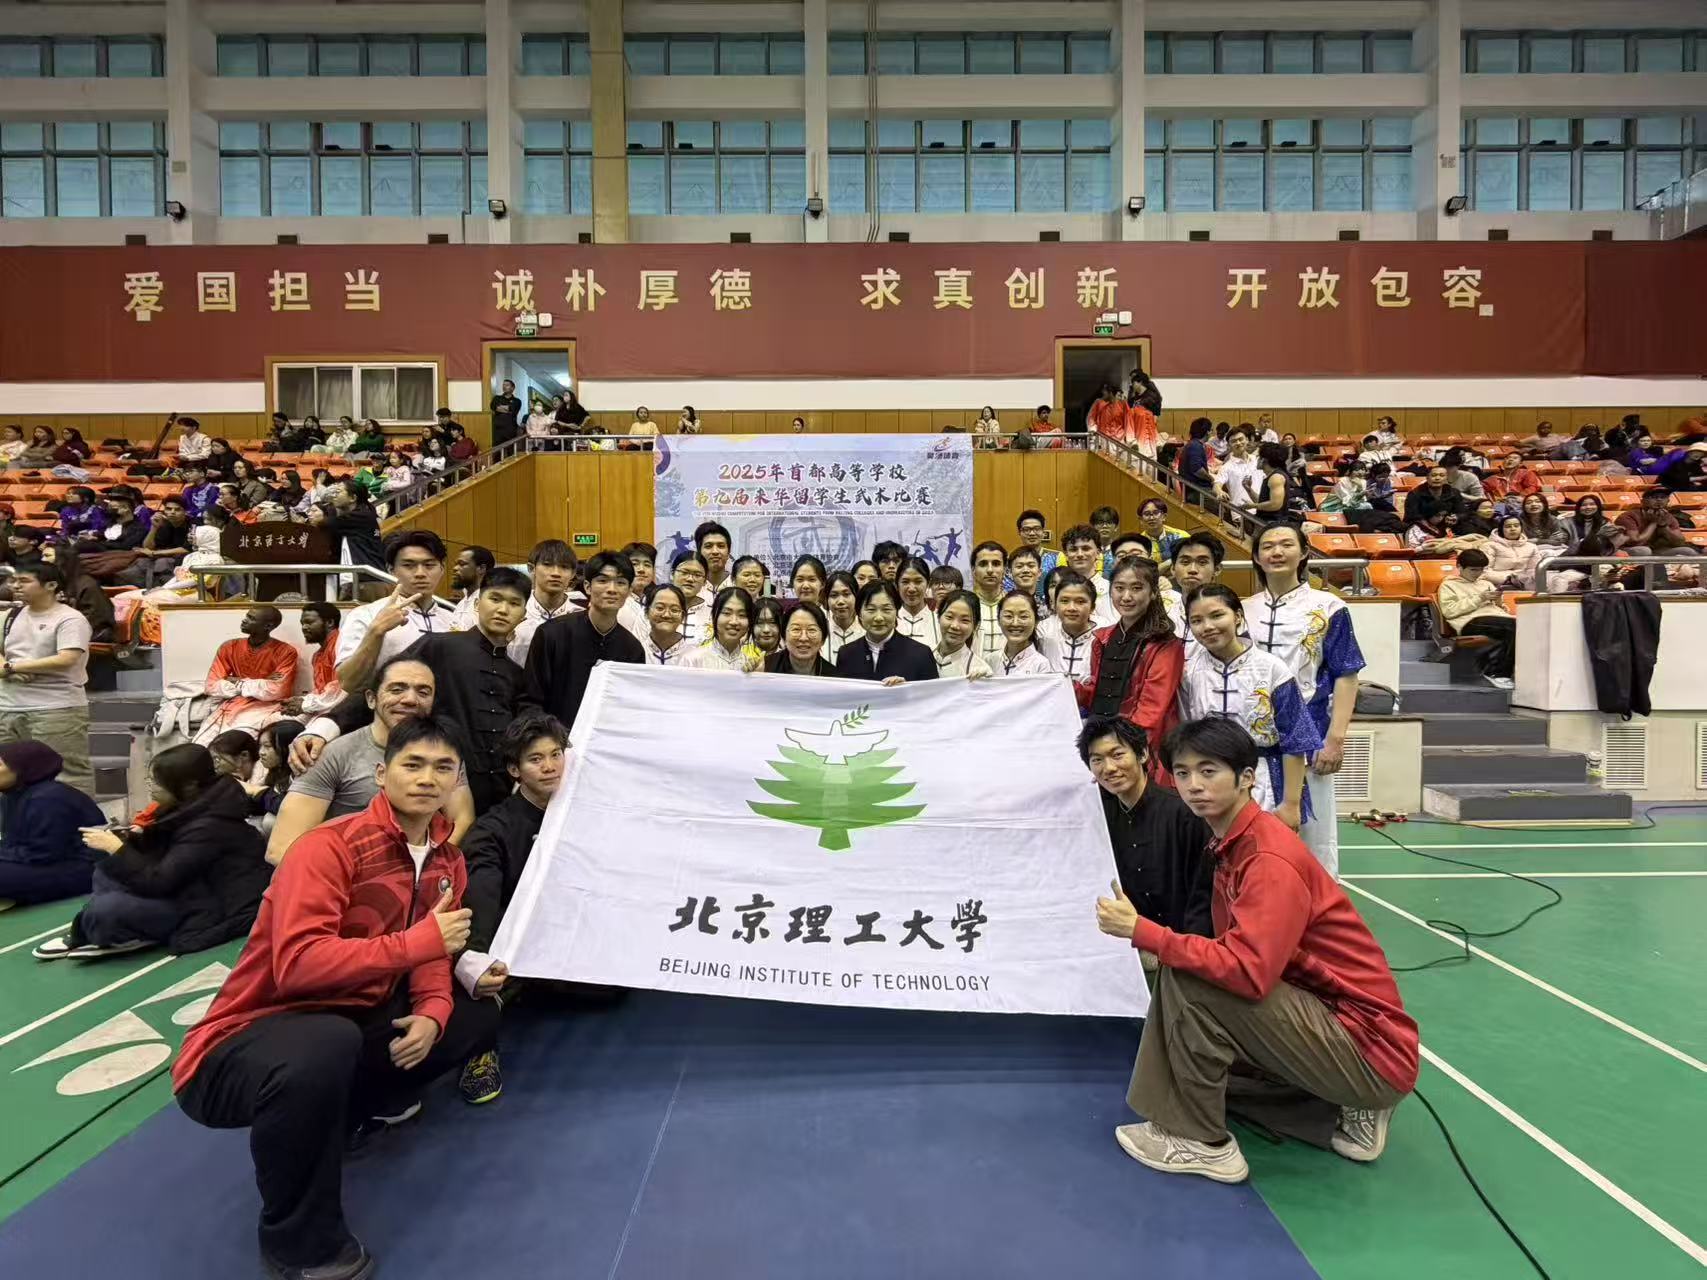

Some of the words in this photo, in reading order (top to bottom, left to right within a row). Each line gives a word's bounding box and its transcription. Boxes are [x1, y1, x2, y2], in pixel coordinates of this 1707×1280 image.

[124, 269, 381, 312] 爱国担当
[491, 269, 752, 312] 诚朴厚德
[860, 267, 1119, 310] 求真创新
[1226, 266, 1483, 309] 开放包容
[719, 463, 907, 483] 2025年首都高等学校
[694, 486, 933, 507] 第九届来华留学生武术比赛
[659, 957, 731, 979] BEIJING
[739, 965, 832, 987] INSTITUTE
[841, 972, 862, 988] OF
[873, 974, 990, 991] TECHNOLOGY
